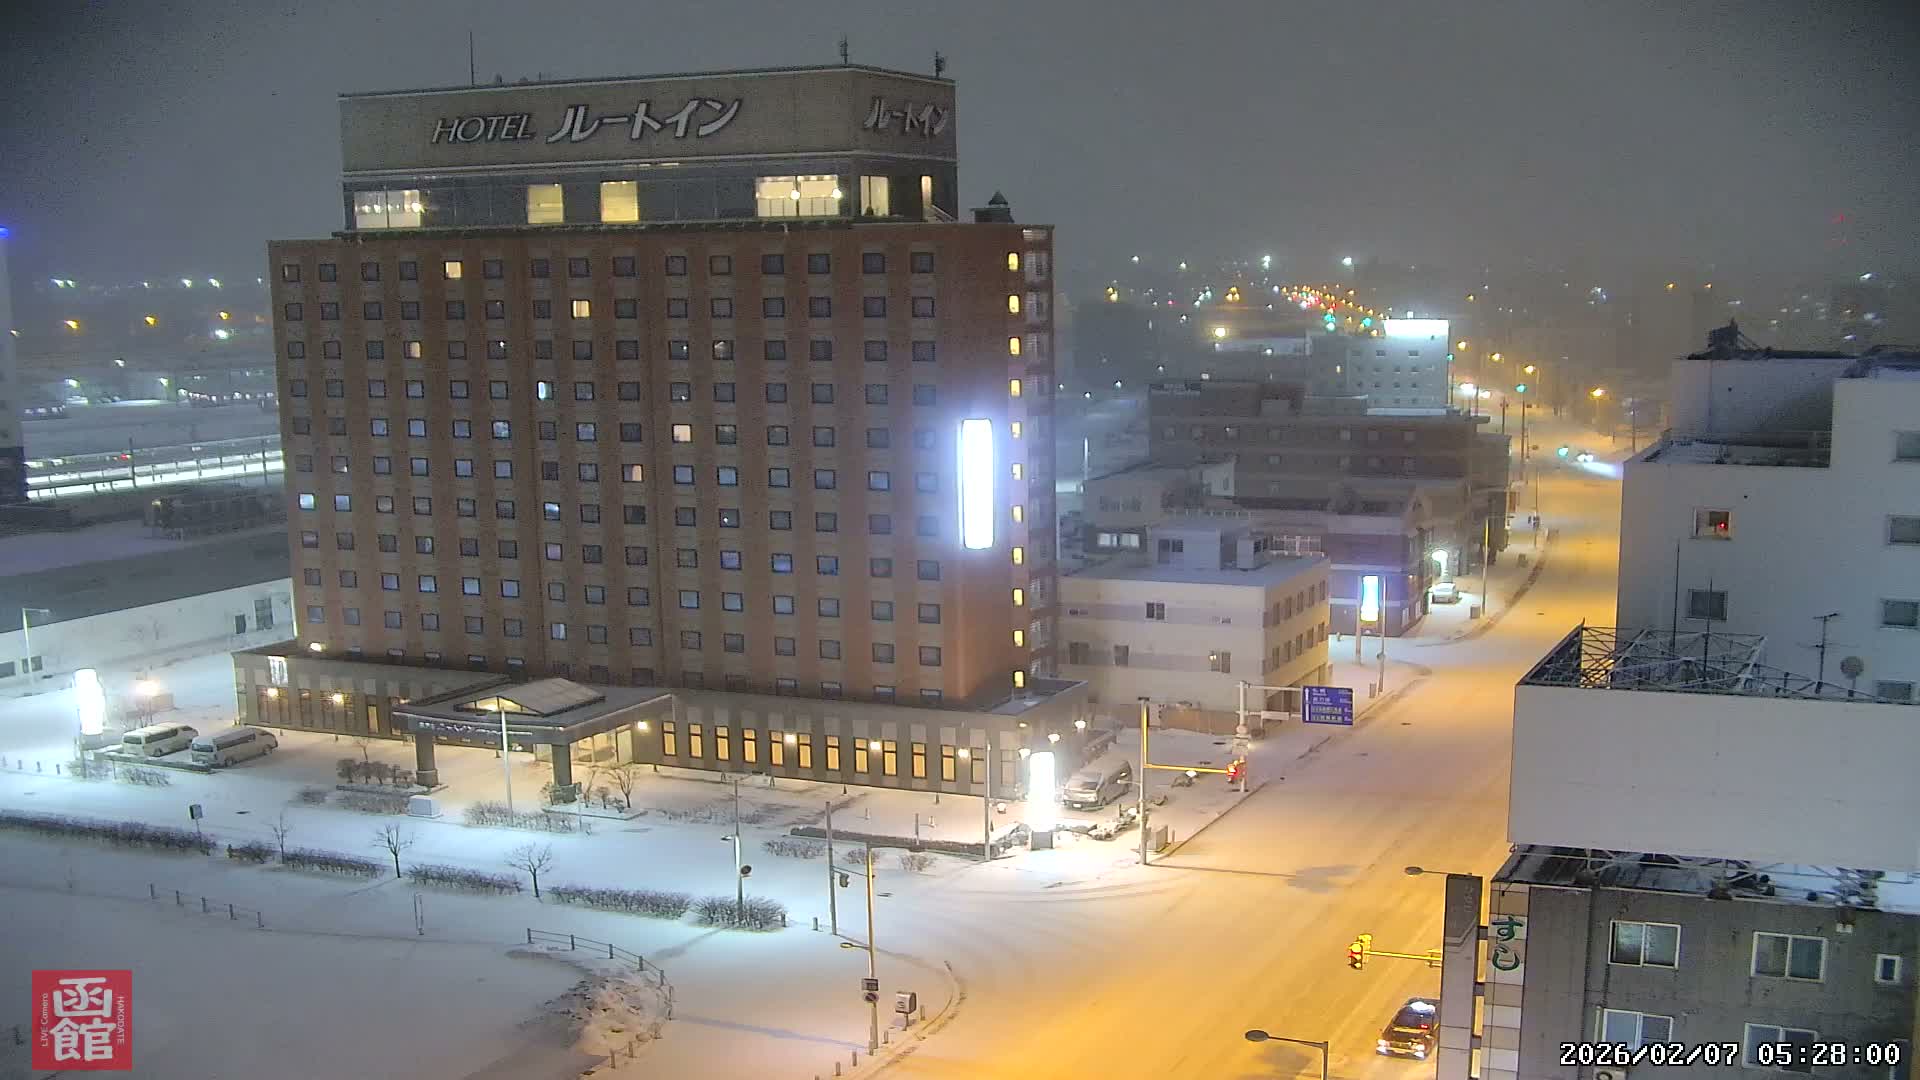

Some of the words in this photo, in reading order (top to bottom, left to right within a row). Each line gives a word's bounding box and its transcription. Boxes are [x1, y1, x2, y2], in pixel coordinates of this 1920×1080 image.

[431, 113, 532, 144] HOTEL
[546, 99, 742, 143] ルートイン
[863, 97, 948, 136] ルートイン
